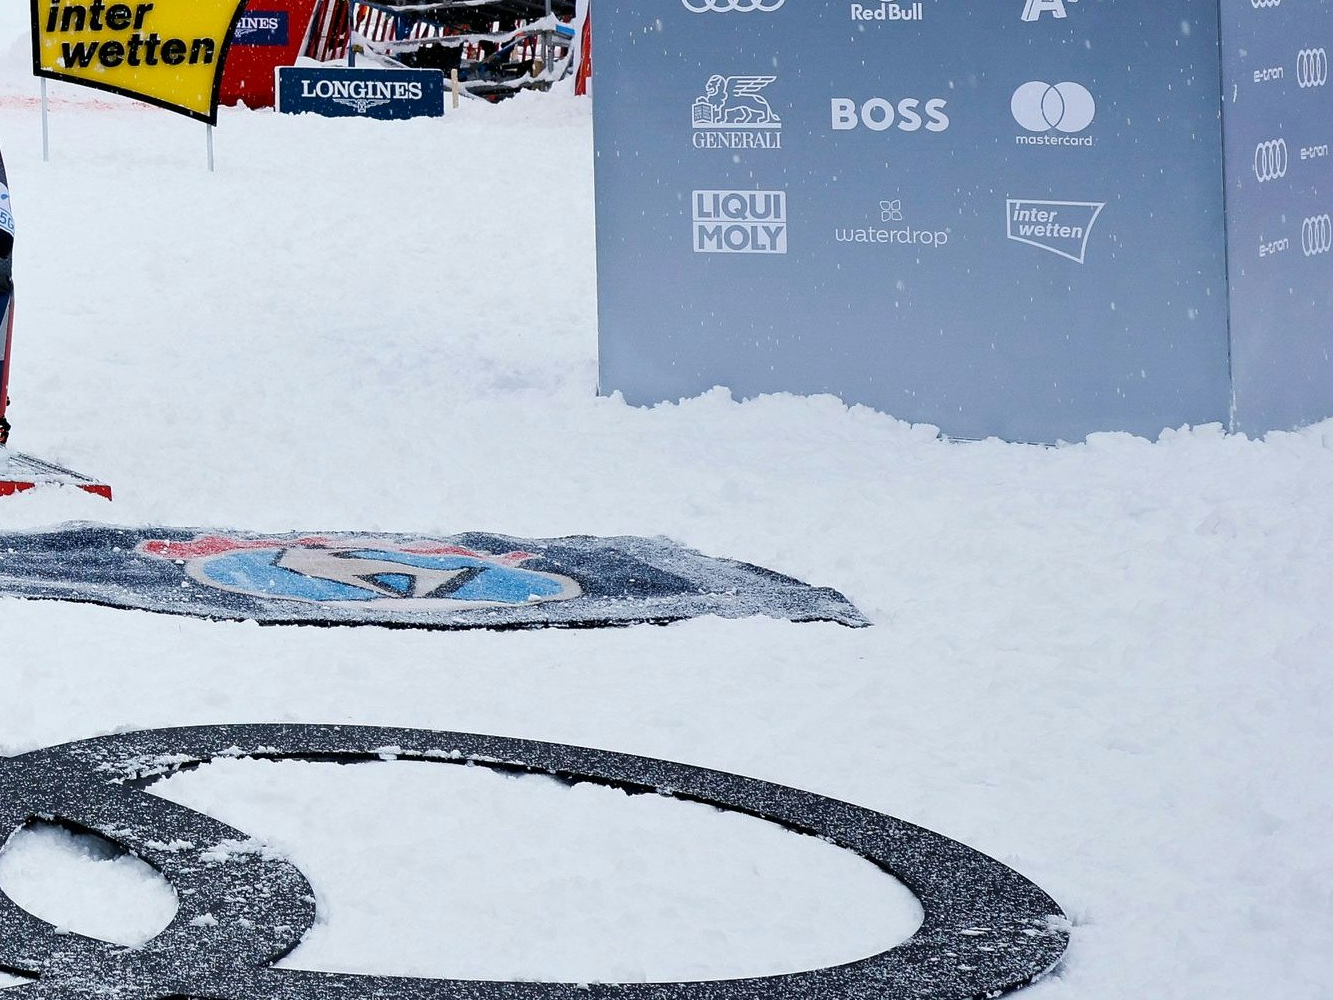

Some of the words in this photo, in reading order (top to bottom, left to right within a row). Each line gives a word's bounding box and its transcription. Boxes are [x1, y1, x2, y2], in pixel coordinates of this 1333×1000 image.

[61, 33, 216, 69] wetten
[1254, 67, 1283, 83] e-tron
[301, 80, 422, 100] LONGINES
[832, 98, 949, 132] BOSS
[693, 131, 781, 150] GENERALI
[1016, 134, 1093, 147] mastercard
[1301, 144, 1328, 160] e-tron
[697, 192, 781, 222] LIQUI
[1013, 205, 1058, 224] inter
[697, 224, 784, 250] MOLY
[835, 225, 947, 248] waterdrop
[1019, 221, 1083, 240] wetten
